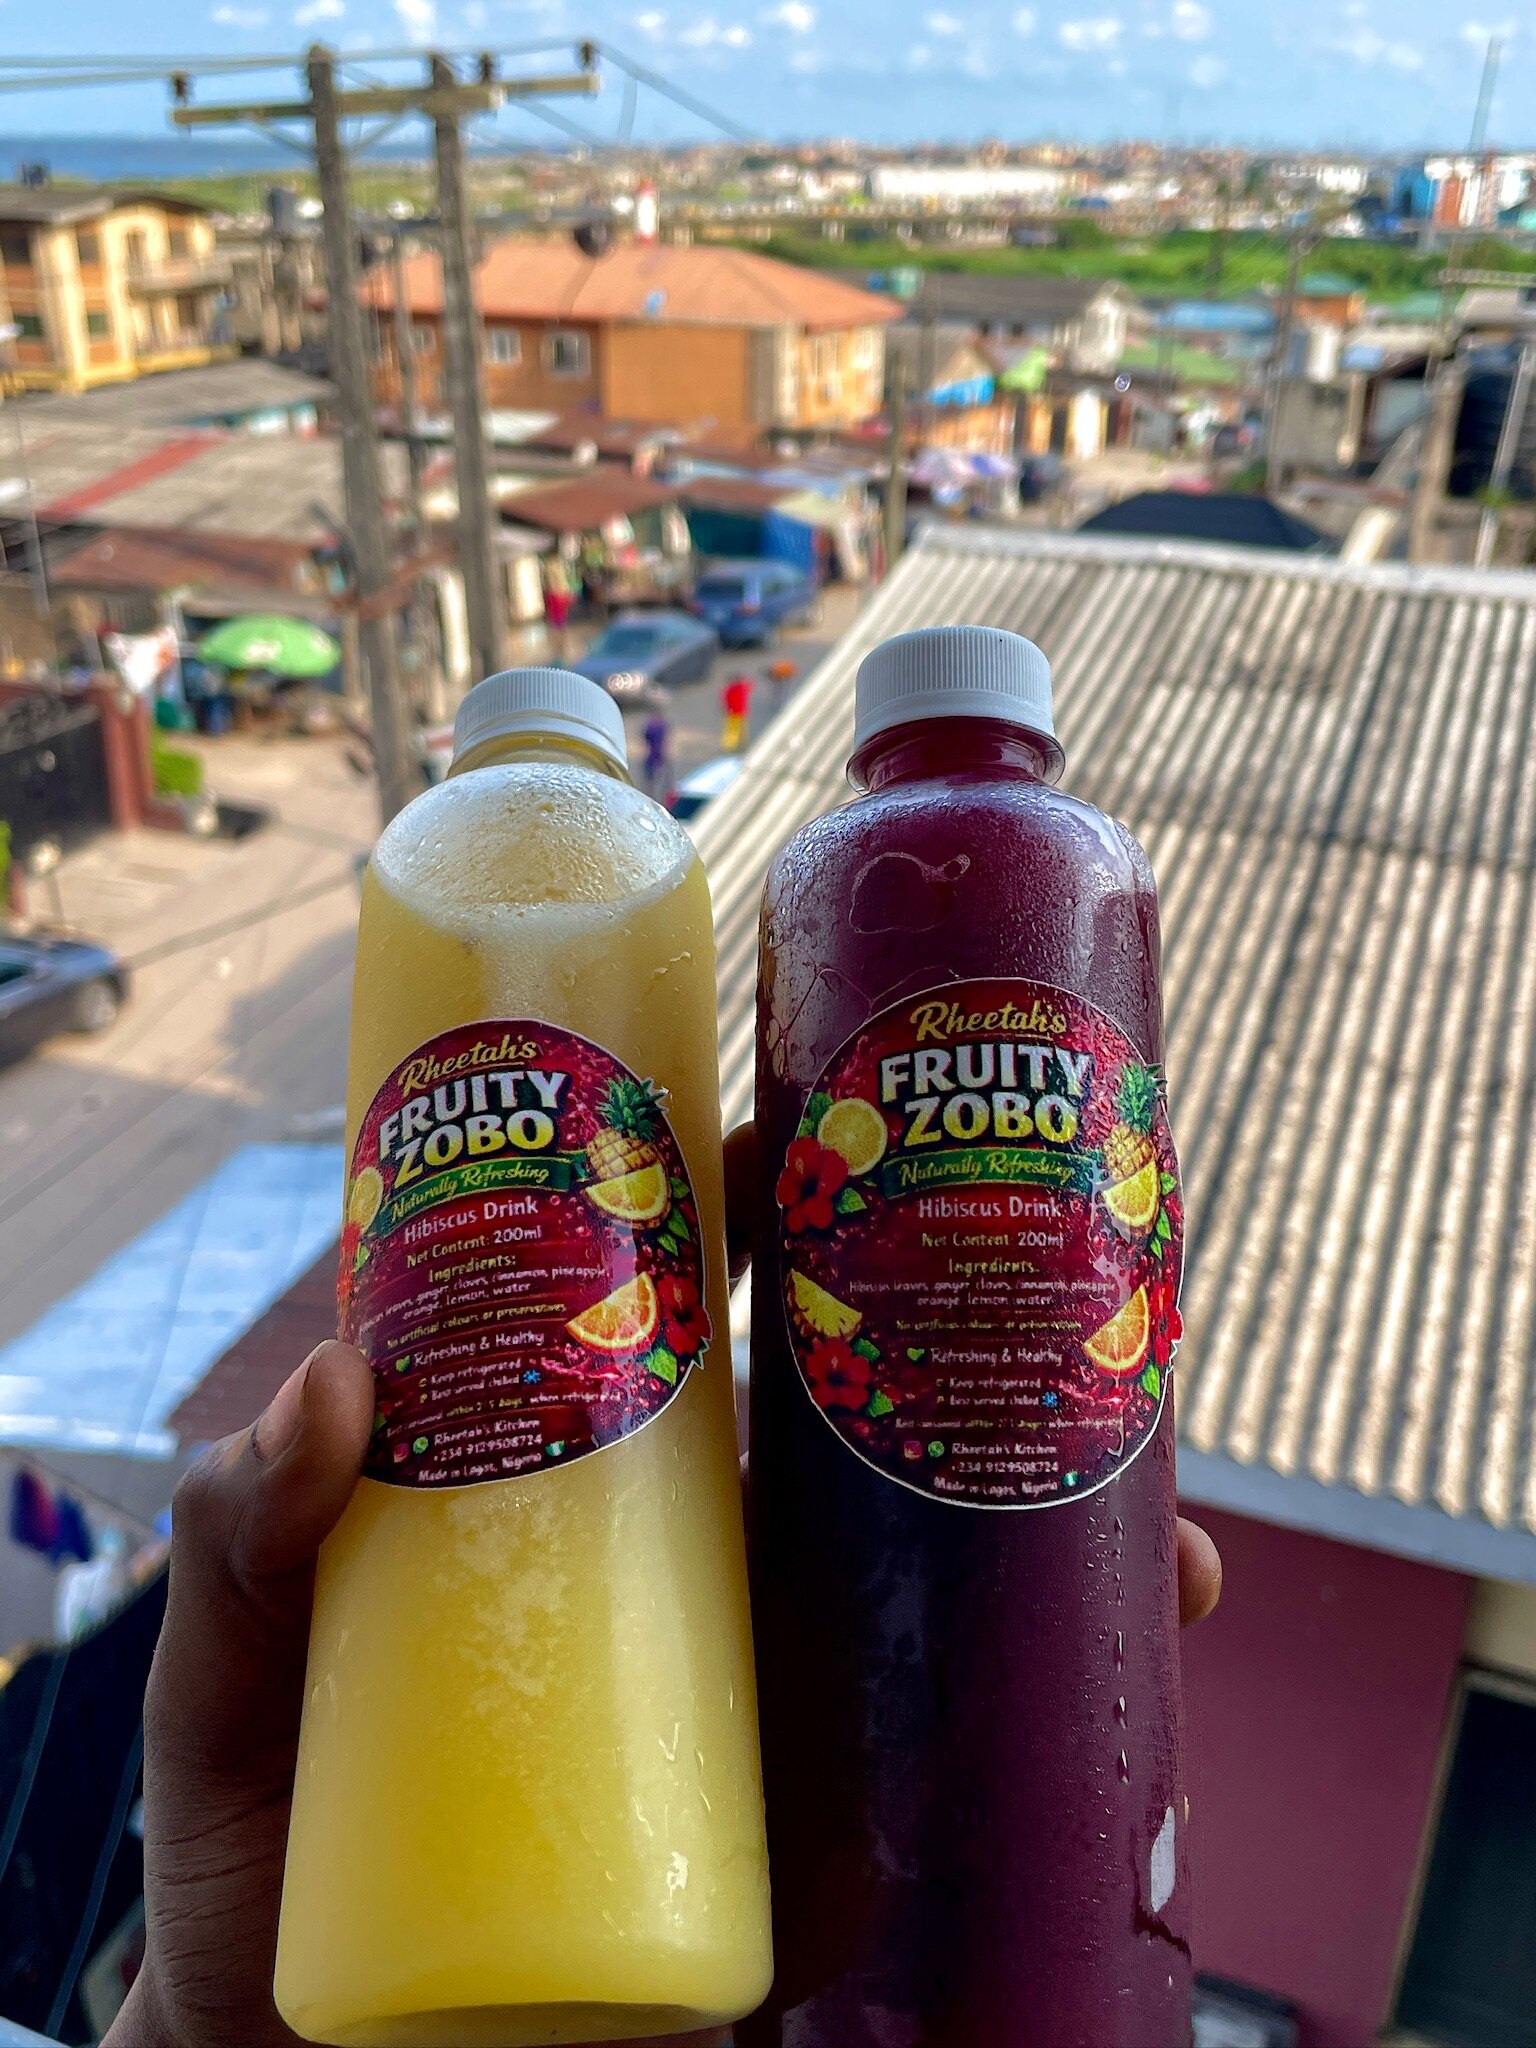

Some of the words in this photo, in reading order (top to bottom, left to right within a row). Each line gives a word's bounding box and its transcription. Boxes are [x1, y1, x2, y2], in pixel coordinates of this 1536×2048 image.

[910, 1001, 1067, 1041] Rheetah's
[397, 1034, 538, 1097] Rheetah's
[881, 1043, 1094, 1103] FRUITY
[380, 1070, 568, 1161] FRUITY
[904, 1092, 1078, 1146] ZOBO
[394, 1109, 554, 1188] ZOBO
[899, 1155, 983, 1186] Naturally
[986, 1151, 1076, 1183] Refreshing
[391, 1179, 458, 1221] Naturally
[461, 1162, 549, 1188] Refreshing
[918, 1196, 1002, 1218] Hibiscus
[1009, 1195, 1062, 1218] Drink
[404, 1208, 477, 1245] Hibiscus
[483, 1195, 539, 1221] Drink
[407, 1252, 428, 1269] Net
[493, 1225, 542, 1245] 200ml
[922, 1232, 947, 1247] Net
[1018, 1231, 1064, 1248] 200ml
[428, 1254, 516, 1284] Ingredients:
[493, 1282, 531, 1296] water
[482, 1311, 493, 1320] or
[414, 1342, 476, 1367] Refreshing
[479, 1337, 491, 1350] &
[495, 1331, 545, 1347] Healthy
[931, 1348, 998, 1367] Refreshing
[1002, 1347, 1012, 1363] &
[1017, 1347, 1063, 1367] Healthy
[431, 1371, 456, 1385] Keep
[458, 1357, 521, 1376] refrigerated
[949, 1377, 975, 1389] Keep
[434, 1424, 491, 1446] Rheetah's
[493, 1417, 541, 1433] Kitchen
[951, 1442, 1010, 1455] Rheetah's
[1014, 1442, 1058, 1455] Kitchen
[419, 1469, 448, 1482] Made
